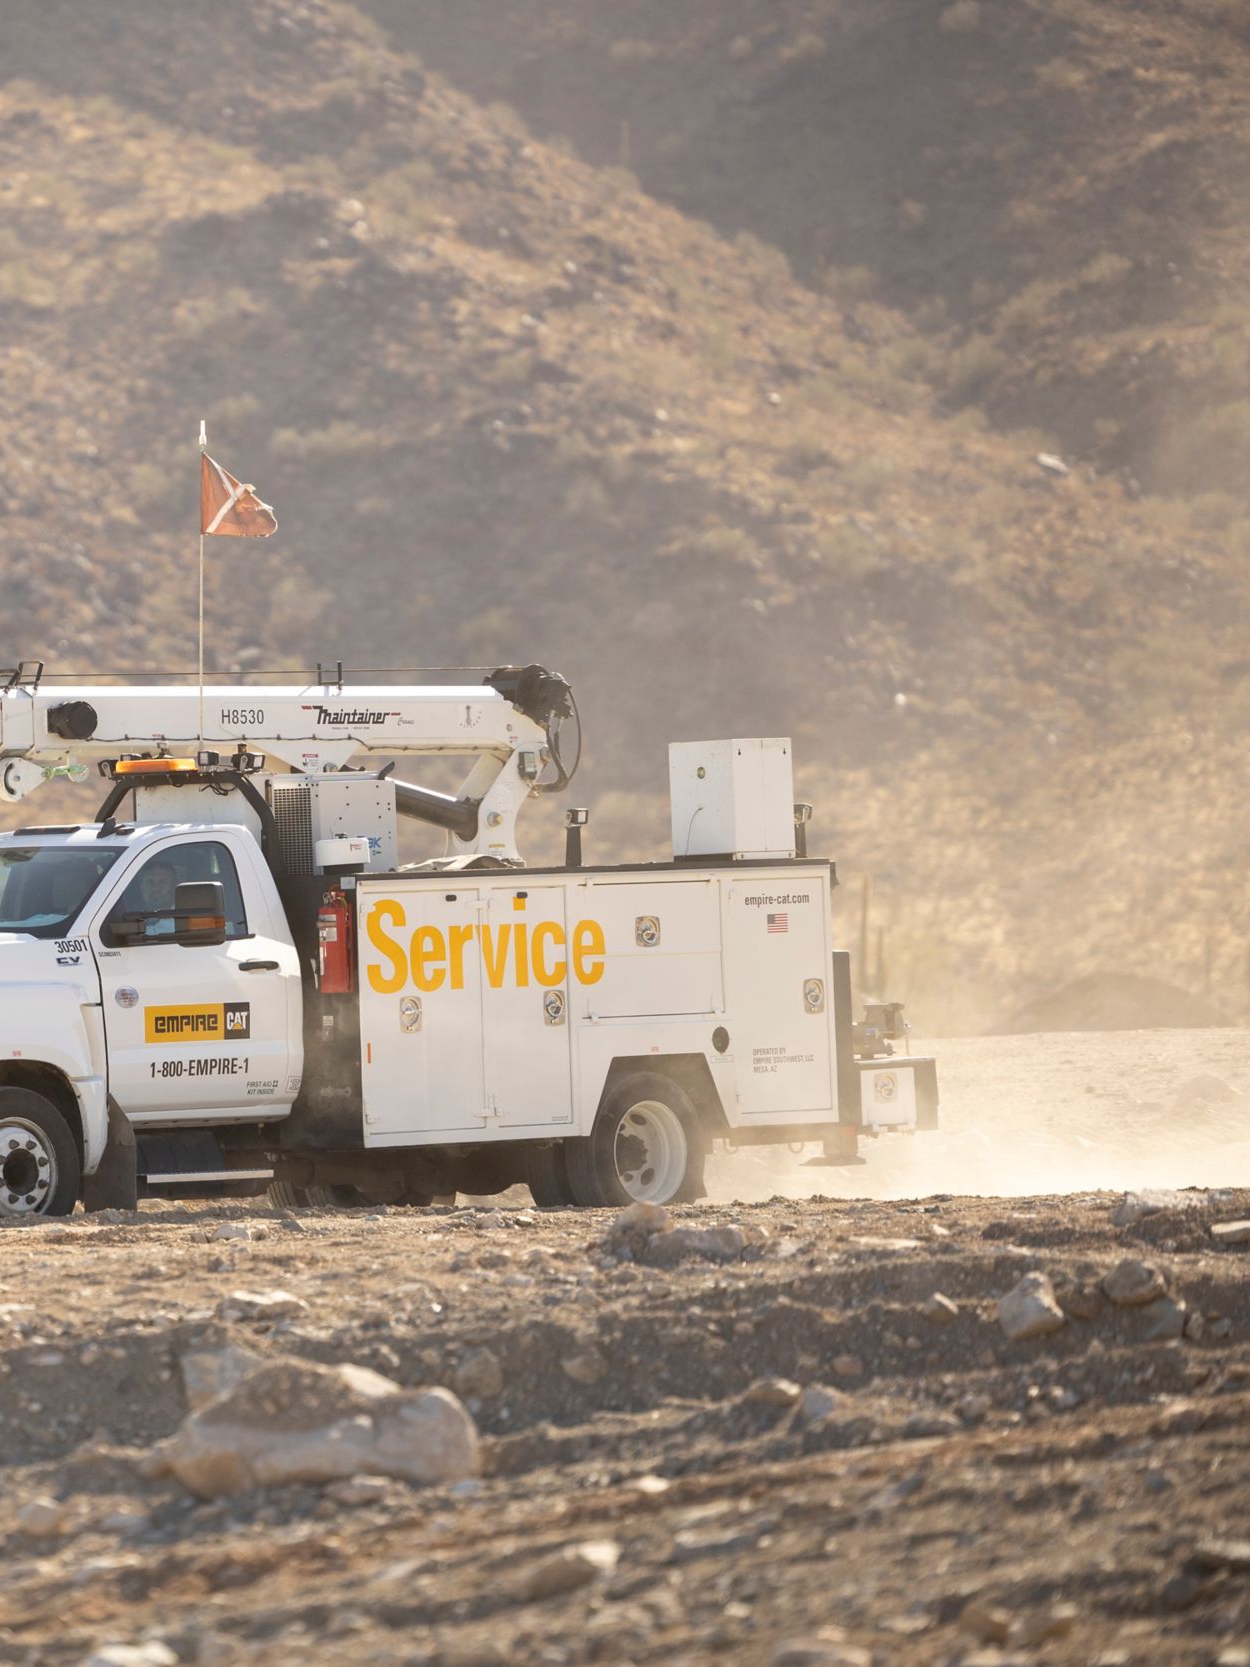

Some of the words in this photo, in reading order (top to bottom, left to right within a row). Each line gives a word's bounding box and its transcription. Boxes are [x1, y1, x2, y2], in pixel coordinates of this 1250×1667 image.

[221, 709, 264, 725] H8530
[313, 704, 390, 725] Maintainer
[744, 893, 810, 908] empire-cat.com
[54, 939, 87, 953] 30501
[366, 897, 606, 994] Service
[226, 1011, 248, 1030] CAT
[150, 1058, 249, 1078] 1-800-EMPIRE-1
